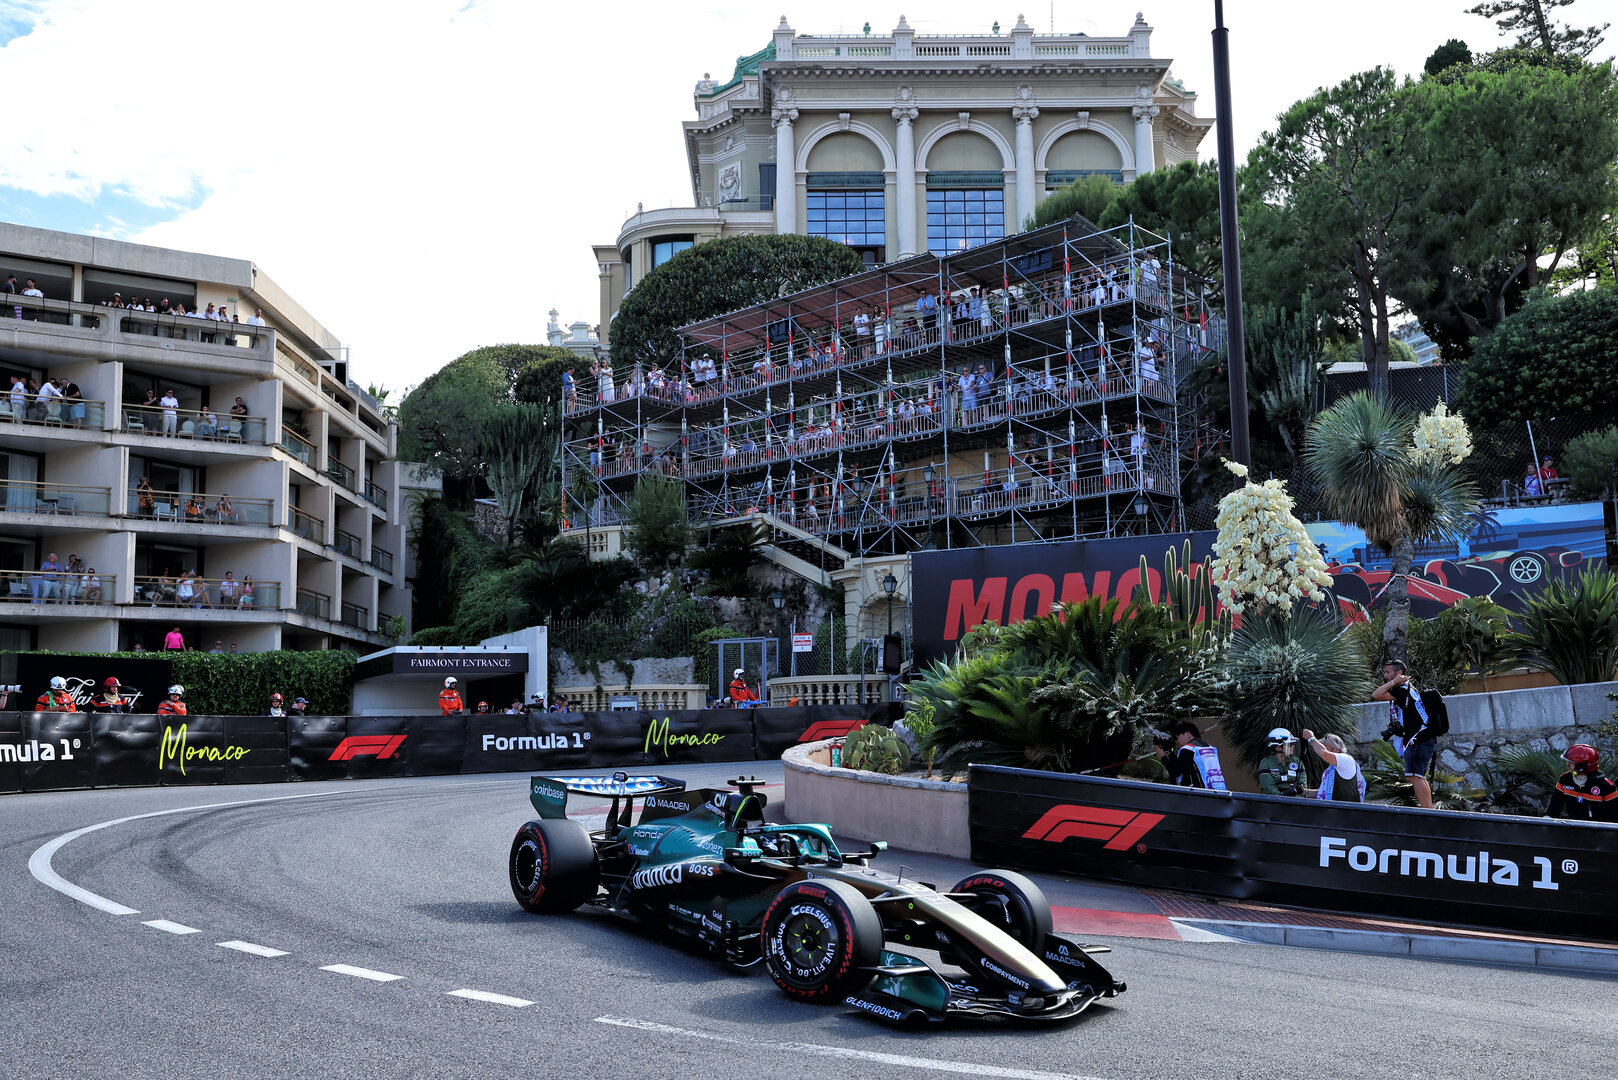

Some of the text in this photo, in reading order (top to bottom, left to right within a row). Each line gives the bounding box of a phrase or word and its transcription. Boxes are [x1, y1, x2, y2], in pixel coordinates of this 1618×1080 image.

[411, 659, 511, 667] FAIRMONT ENTRANCE
[482, 732, 568, 751] Formula
[644, 716, 725, 758] Monaco
[159, 723, 251, 776] Monaco
[533, 784, 565, 800] coinbase
[657, 799, 690, 812] MAADEN
[688, 863, 714, 877] BOSS
[1319, 836, 1520, 887] Formula
[633, 864, 682, 890] aramco
[964, 877, 1005, 890] ZERO
[799, 905, 832, 929] CELSIUS
[1045, 951, 1086, 969] MAADEN
[985, 961, 1030, 991] COINPAYMENTS
[845, 996, 902, 1020] GLENFIDDICH
